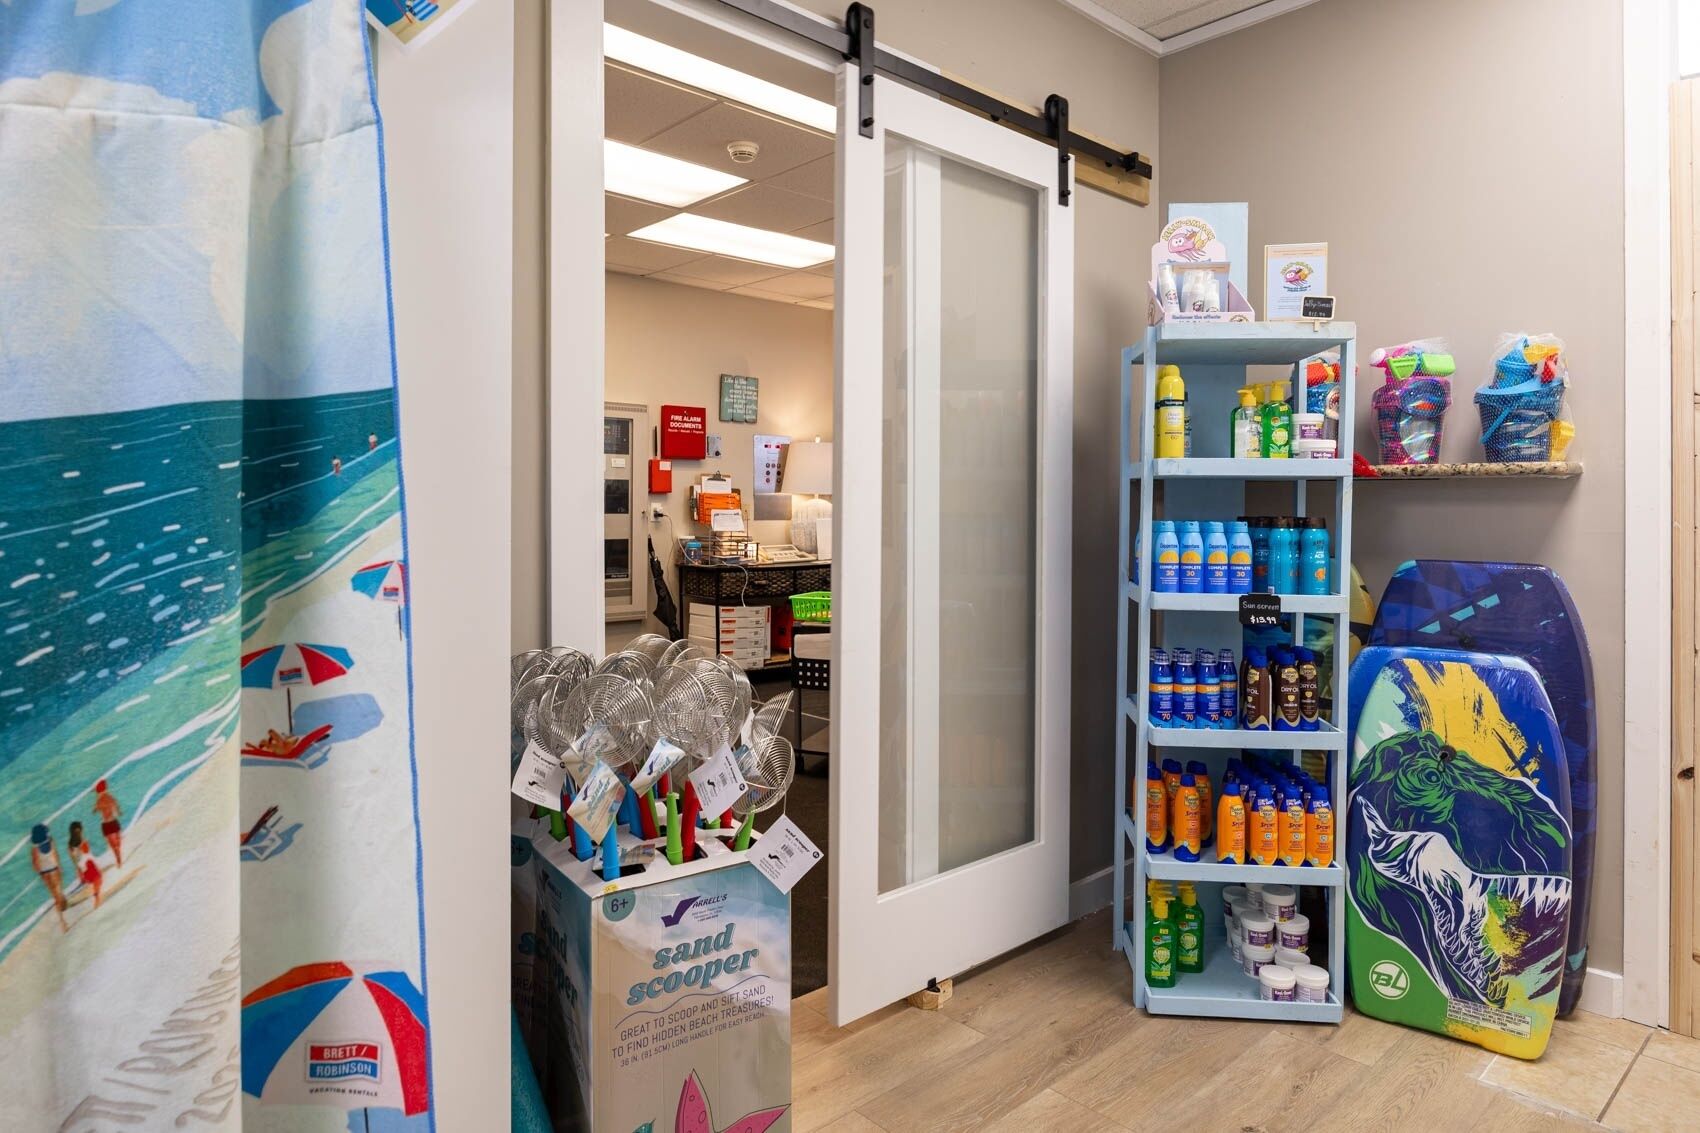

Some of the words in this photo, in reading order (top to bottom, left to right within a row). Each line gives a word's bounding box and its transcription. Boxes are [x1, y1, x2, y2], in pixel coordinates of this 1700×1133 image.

[1242, 600, 1256, 609] Sun
[1257, 602, 1280, 610] screen
[1250, 614, 1276, 624] $13.99
[610, 897, 629, 912] 6+
[653, 922, 736, 969] sand
[627, 948, 759, 1006] scooper
[620, 1022, 650, 1041] GREAT
[653, 1016, 664, 1030] TO
[668, 1006, 698, 1024] SCOOP
[701, 999, 718, 1012] AND
[721, 992, 740, 1007] SIFT
[743, 985, 766, 1000] SAND
[612, 1044, 624, 1059] TO
[627, 1037, 649, 1053] FIND
[652, 1024, 686, 1045] HIDDEN
[689, 1013, 718, 1031] BEACH
[720, 996, 774, 1019] TREASURES!
[620, 1058, 629, 1067] 36
[672, 1037, 689, 1048] LONG
[690, 1029, 713, 1043] HANDLE
[714, 1023, 727, 1033] FOR
[728, 1018, 743, 1030] EASY
[323, 1046, 358, 1059] BRETT
[316, 1063, 372, 1076] ROBINSON
[309, 1087, 346, 1095] VACATION
[348, 1088, 378, 1097] RENTALS
